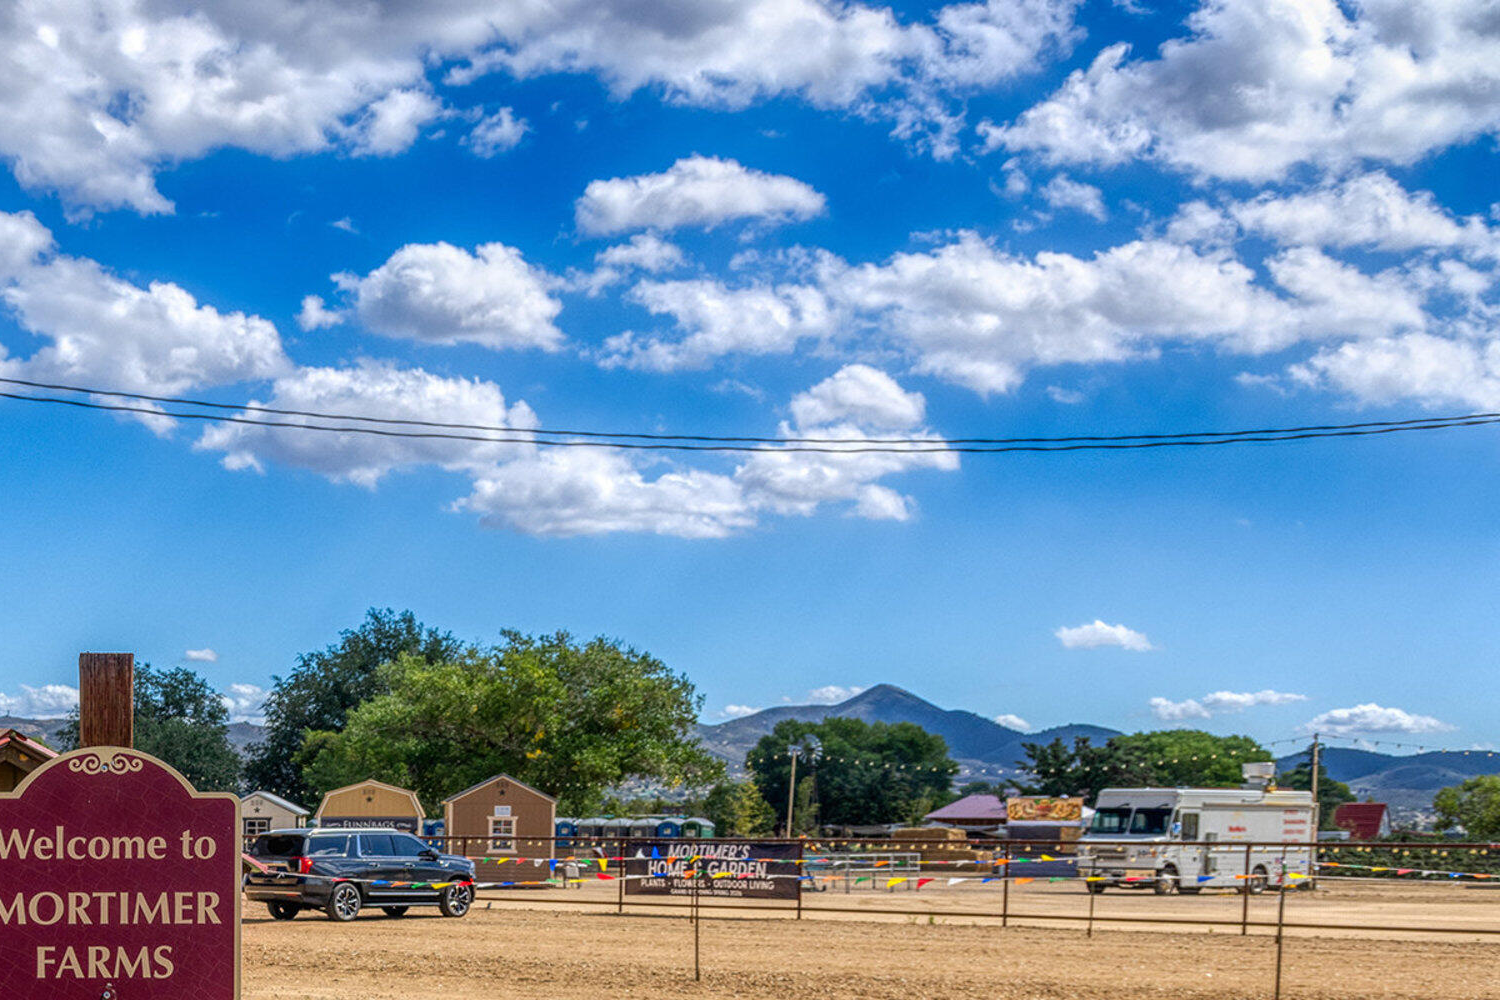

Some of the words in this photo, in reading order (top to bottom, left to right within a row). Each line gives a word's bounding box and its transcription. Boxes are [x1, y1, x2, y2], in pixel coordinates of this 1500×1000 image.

[180, 829, 217, 860] to
[668, 844, 751, 859] MORTIMER'S
[648, 860, 688, 877] HOME
[707, 861, 768, 878] GARDEN
[641, 879, 666, 888] PLANTS
[713, 880, 748, 889] OUTDOOR
[749, 881, 775, 890] LIVING
[36, 945, 174, 979] FARMS
